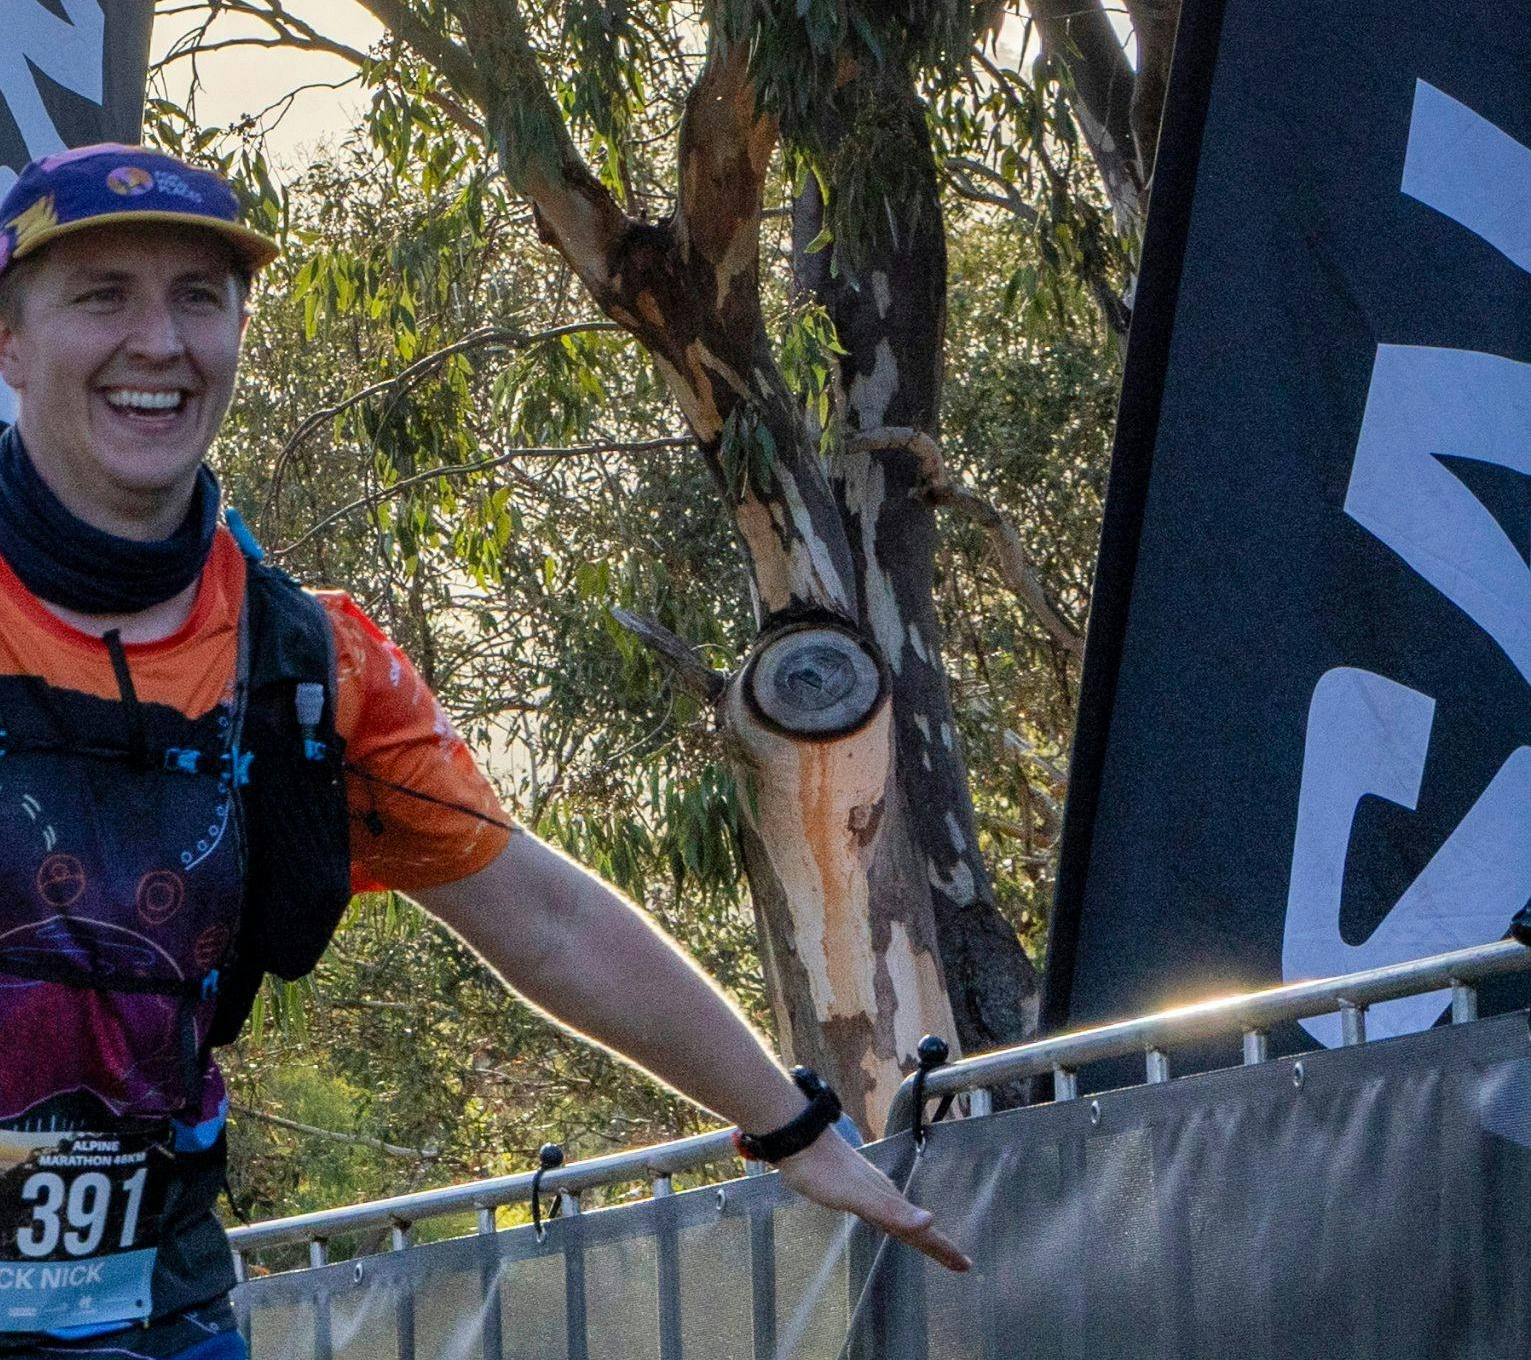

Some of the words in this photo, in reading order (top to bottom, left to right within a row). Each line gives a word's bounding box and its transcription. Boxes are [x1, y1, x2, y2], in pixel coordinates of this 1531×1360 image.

[72, 1140, 120, 1152] ALPINE
[38, 1155, 112, 1167] MARATHON
[16, 1167, 149, 1257] 391
[40, 1262, 106, 1289] NICK
